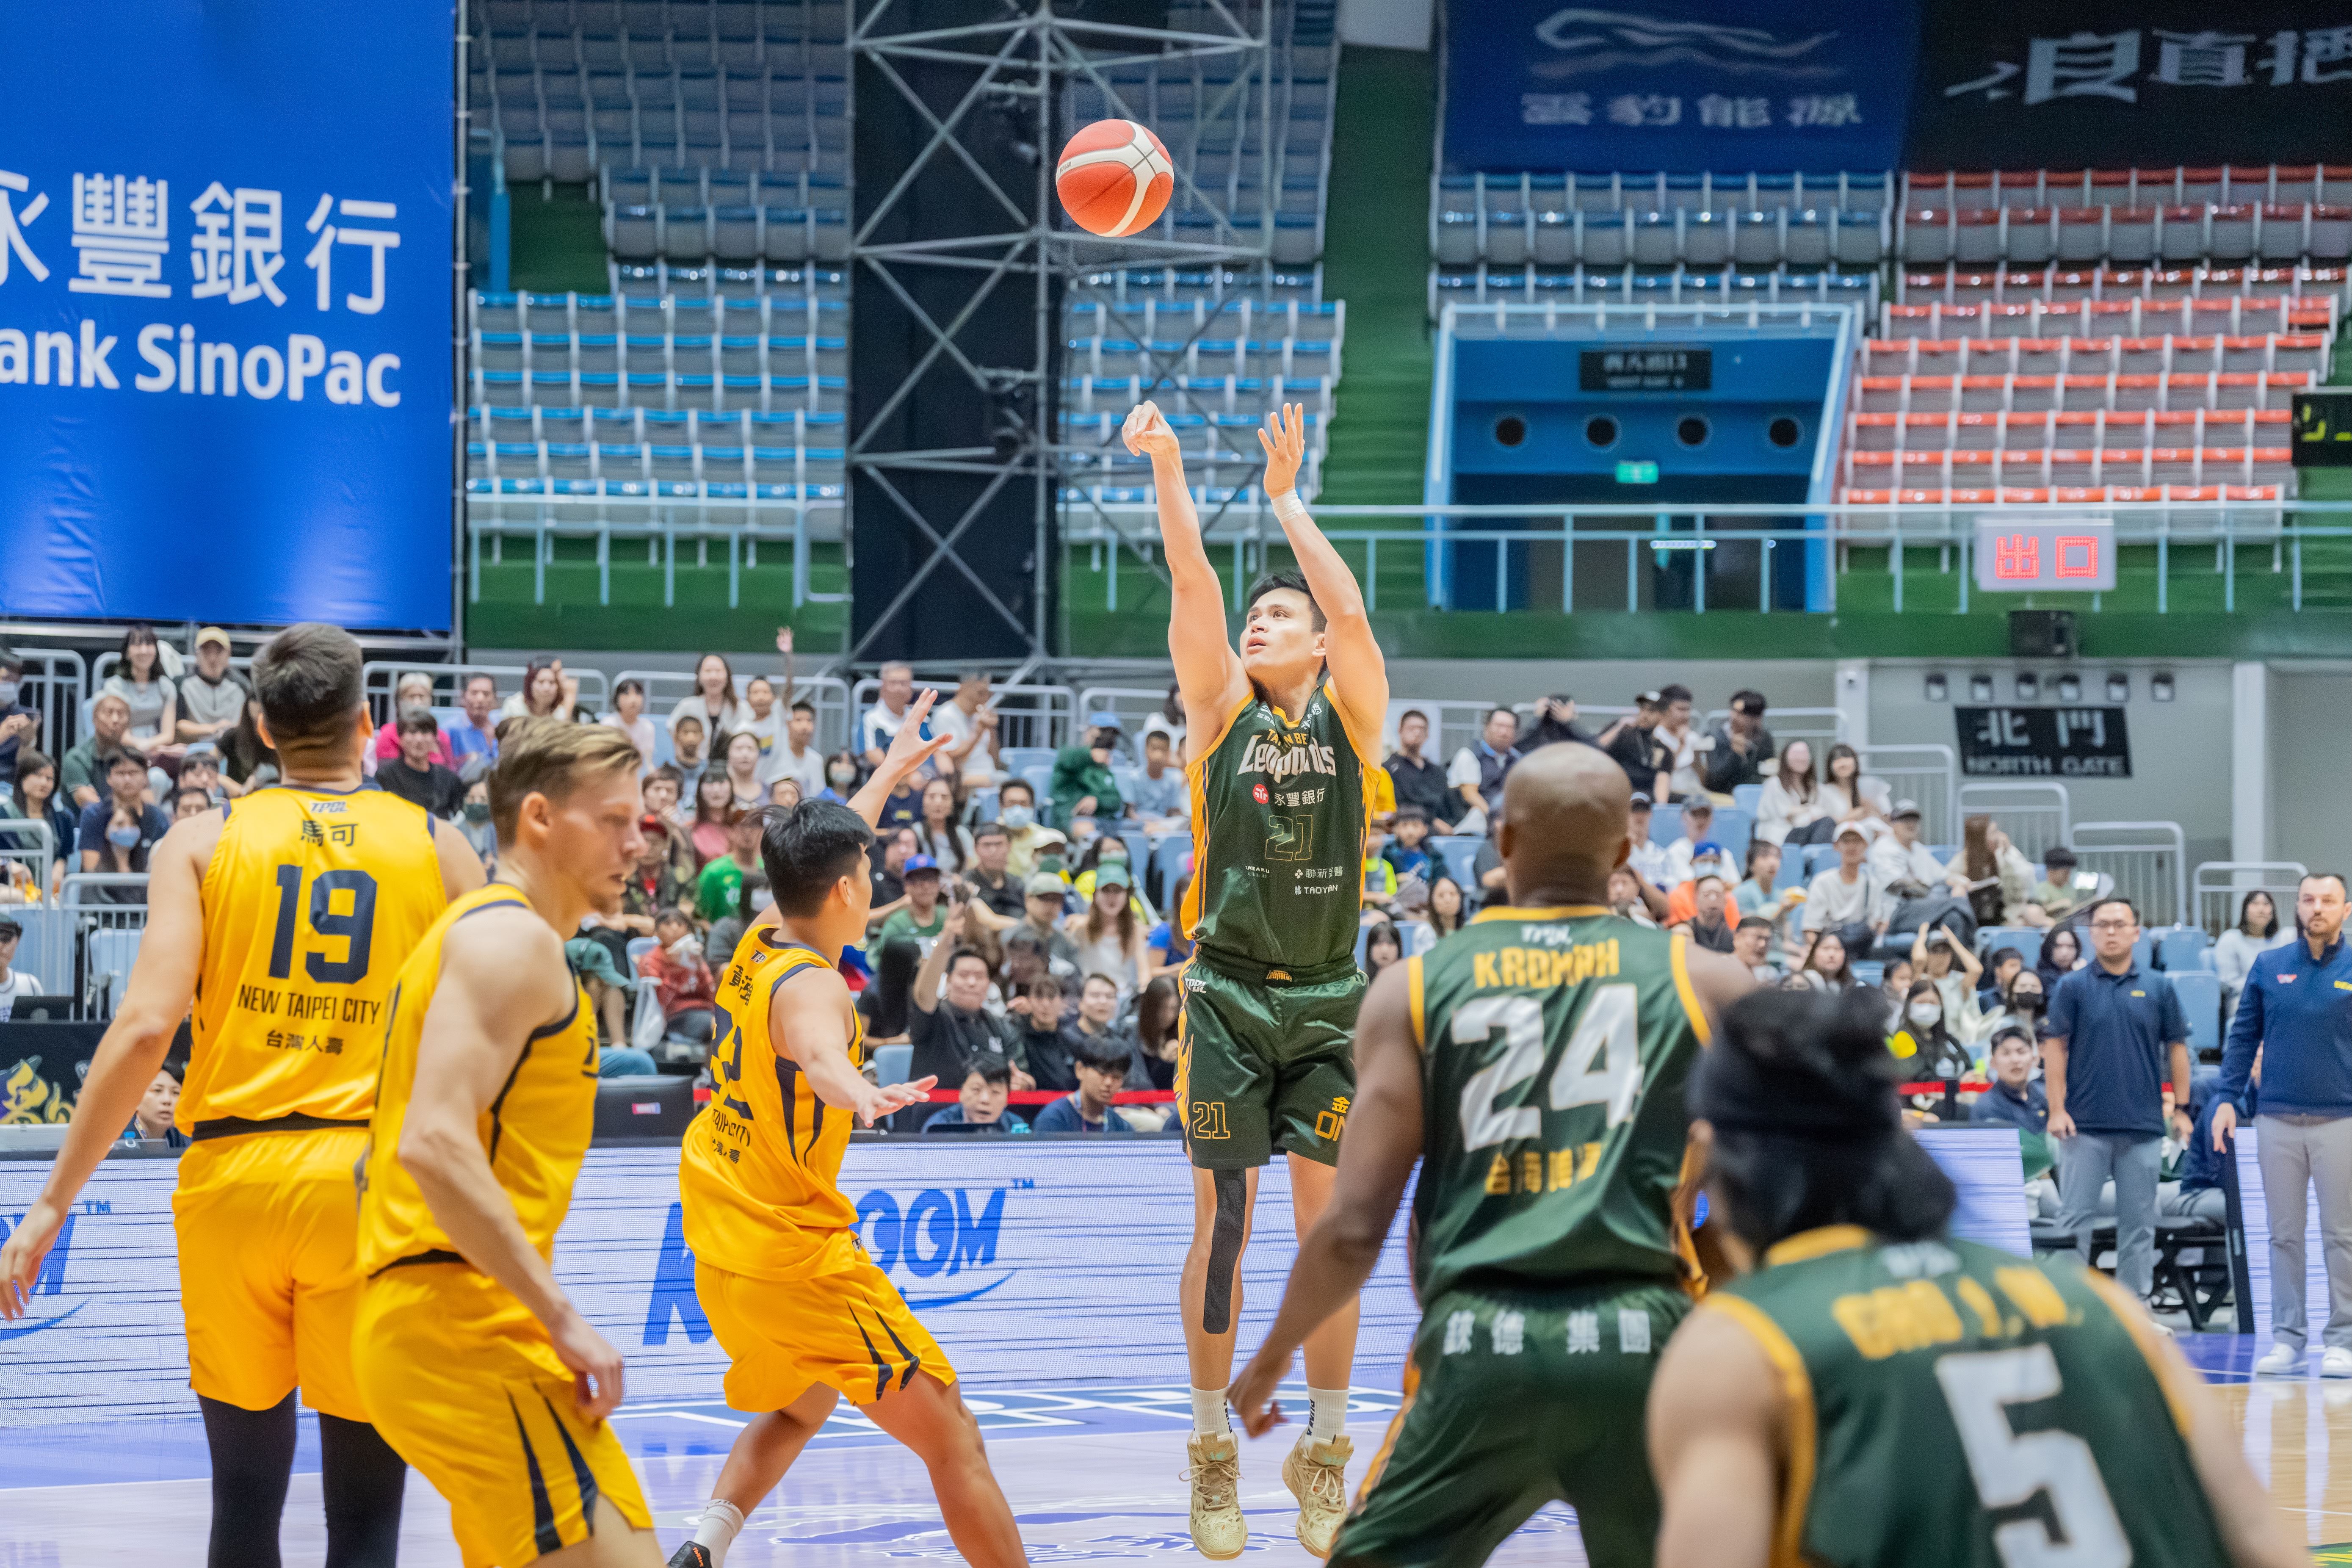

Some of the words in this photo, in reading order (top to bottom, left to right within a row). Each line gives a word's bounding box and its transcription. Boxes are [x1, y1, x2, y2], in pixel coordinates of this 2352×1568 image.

[0, 319, 120, 389] ank
[135, 324, 401, 408] SinoPac
[1995, 534, 2098, 579] 出口
[1976, 708, 2106, 748] 北門
[1274, 788, 1325, 807] 永豐銀行
[301, 819, 359, 847] 馬可
[1265, 815, 1313, 861] 21
[268, 864, 378, 984] 19
[238, 984, 281, 1014] NEW
[287, 993, 337, 1020] TAIPEI
[342, 998, 381, 1025] CITY
[266, 1029, 344, 1056] 台灣人壽
[1451, 983, 1645, 1153] 24
[1193, 1101, 1230, 1139] 21
[1934, 1341, 2133, 1568] 5
